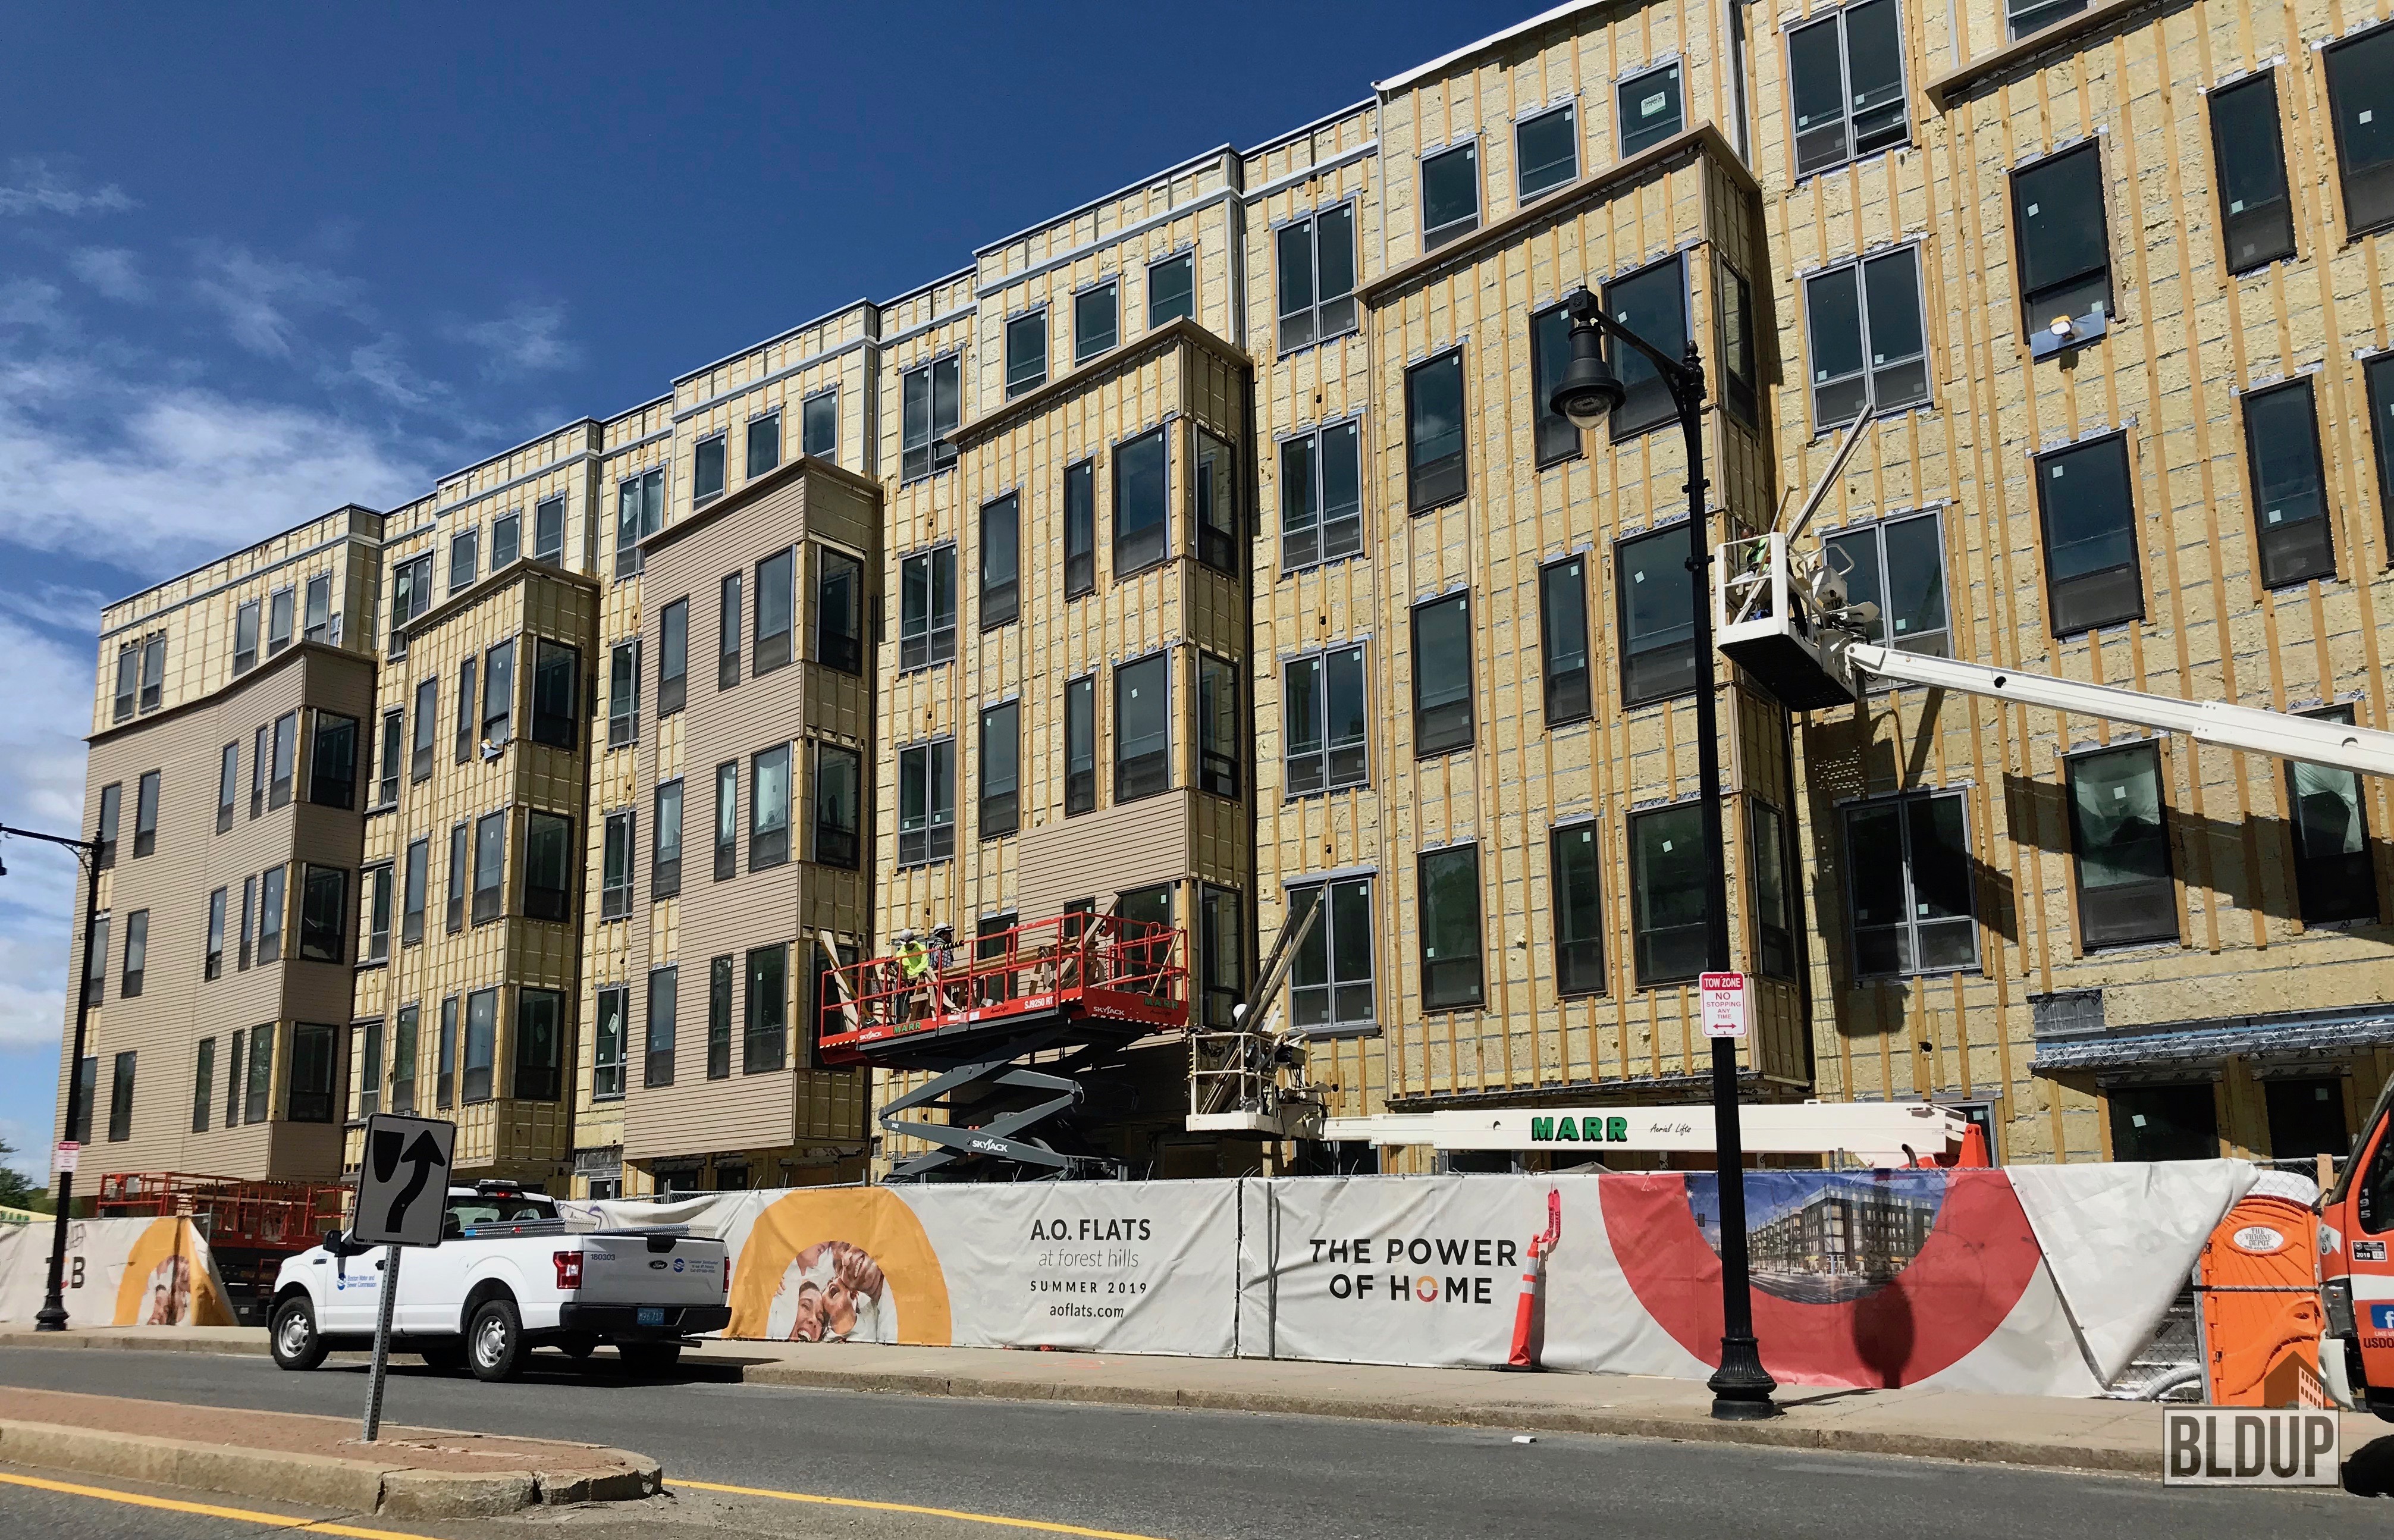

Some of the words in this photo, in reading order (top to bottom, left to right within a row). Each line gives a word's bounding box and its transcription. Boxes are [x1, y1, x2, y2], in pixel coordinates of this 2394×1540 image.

[1704, 978, 1720, 987] TOW
[1722, 977, 1741, 987] ZONE
[1024, 998, 1045, 1009] SJ9250
[1046, 996, 1054, 1005] RT
[1144, 997, 1178, 1009] MARR
[1093, 1006, 1125, 1015] SKYJACK
[893, 1022, 921, 1034] MARR
[1532, 1116, 1628, 1142] MARR
[1649, 1123, 1673, 1133] Aerial
[1675, 1123, 1692, 1136] Lifts
[972, 1138, 1008, 1152] SKYJACK
[1030, 1219, 1072, 1240] A.O.
[1080, 1219, 1151, 1241] FLATS
[1038, 1249, 1053, 1266] at
[1058, 1249, 1103, 1267] forest
[1108, 1249, 1138, 1267] hills
[1310, 1238, 1371, 1263] THE
[1386, 1238, 1517, 1266] POWER
[1030, 1281, 1097, 1293] SUMMER
[1108, 1282, 1147, 1294] 2019
[1329, 1274, 1373, 1299] OF
[1390, 1275, 1492, 1304] HOME
[1050, 1303, 1124, 1318] aoflats.com
